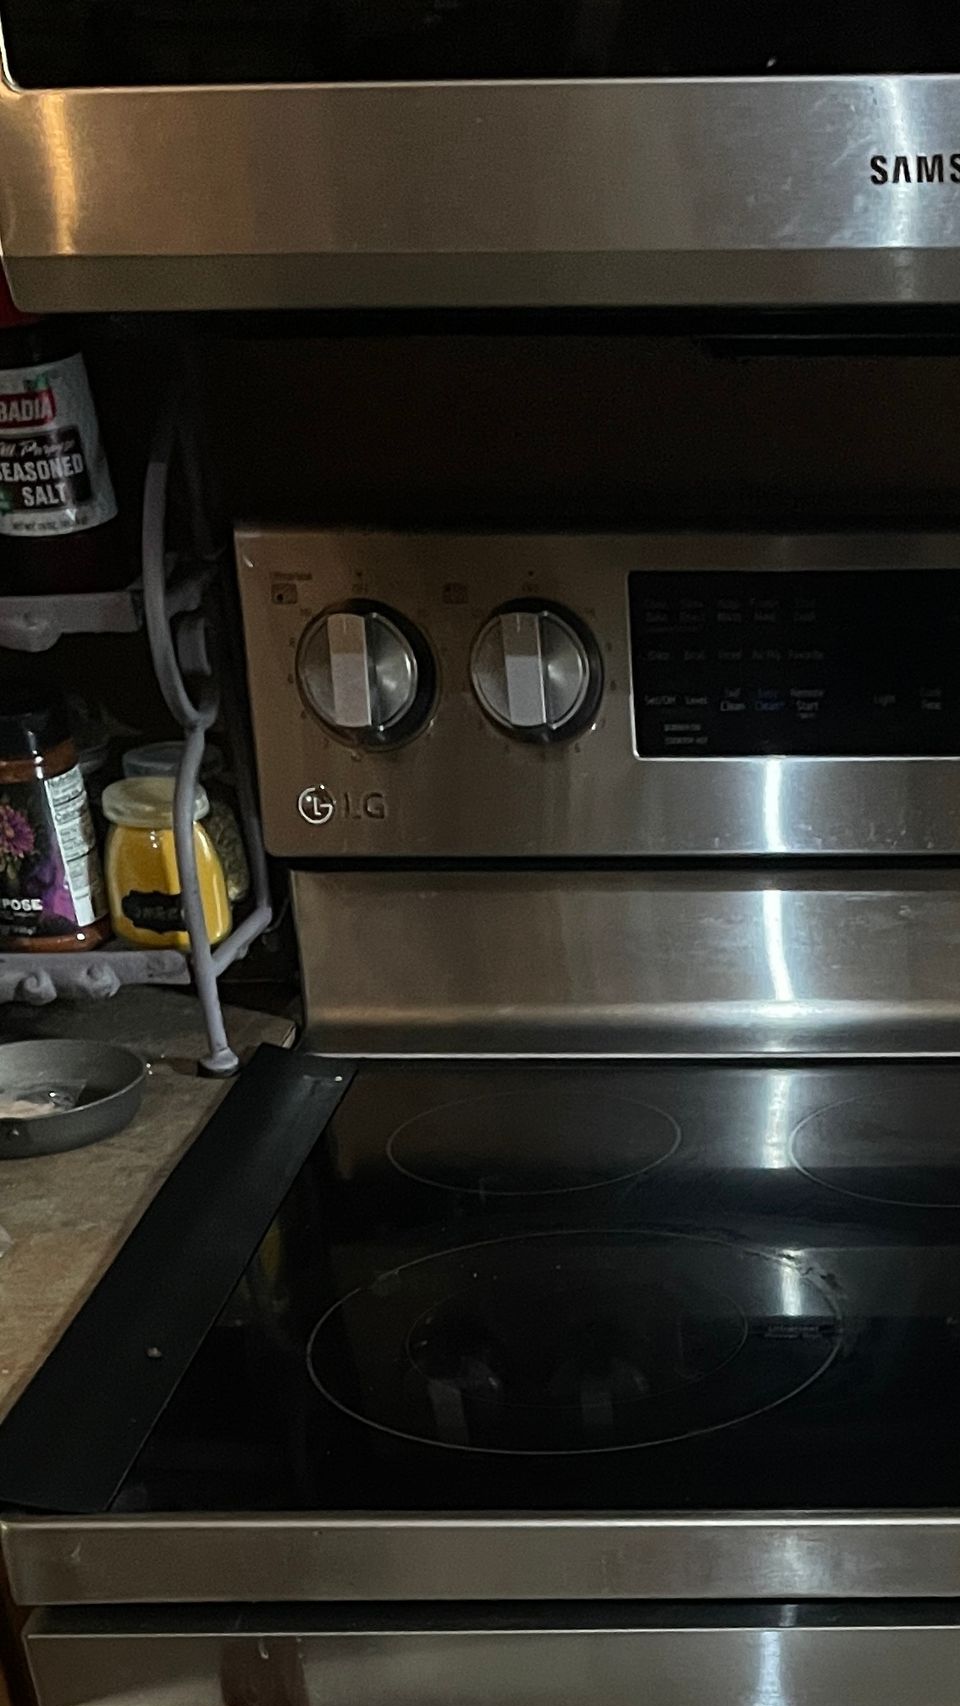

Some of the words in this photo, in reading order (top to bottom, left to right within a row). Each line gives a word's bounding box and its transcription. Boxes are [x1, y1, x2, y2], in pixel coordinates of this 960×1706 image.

[0, 452, 84, 483] EASONED
[22, 481, 68, 508] SALT
[344, 792, 386, 819] LG
